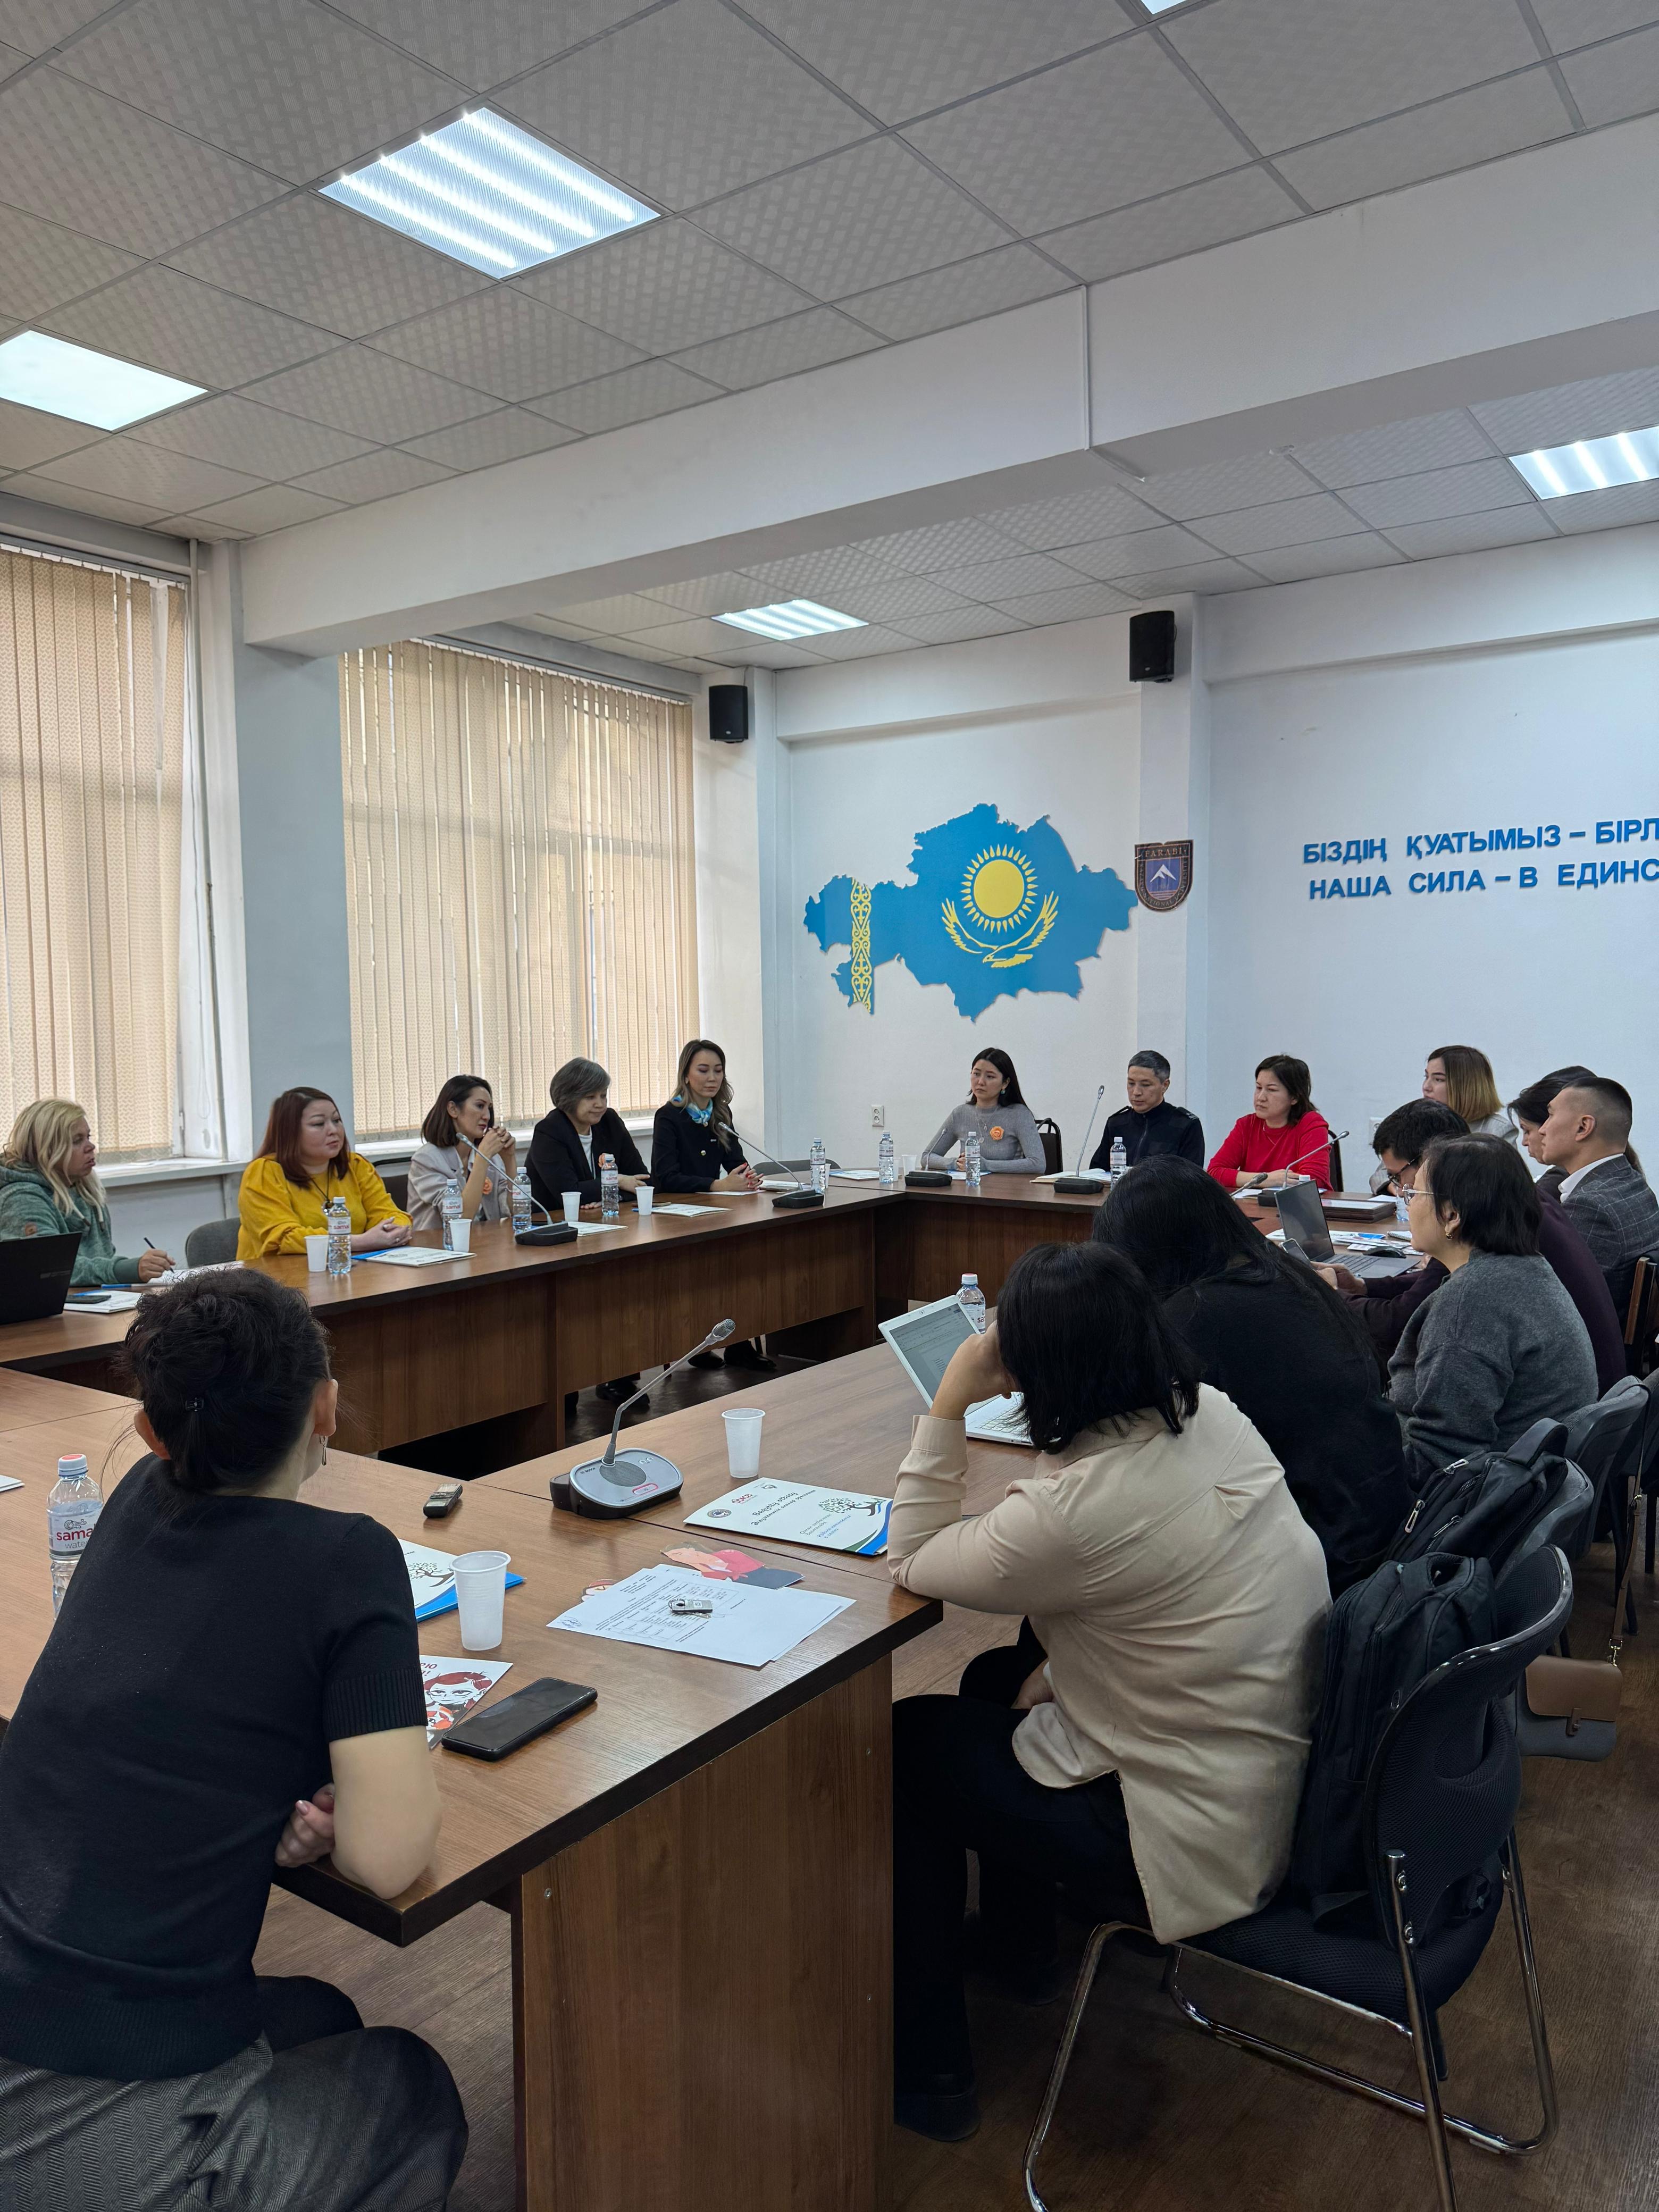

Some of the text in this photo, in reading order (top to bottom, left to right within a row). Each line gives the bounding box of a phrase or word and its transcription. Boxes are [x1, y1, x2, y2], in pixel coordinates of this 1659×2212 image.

[1303, 838, 1387, 864] БІЗДІҢ
[1406, 825, 1561, 859] ҚУАТЫМЫЗ
[1310, 876, 1390, 899] НАША
[1408, 869, 1486, 893] СИЛА
[1519, 867, 1538, 888] В
[56, 1524, 96, 1541] sama
